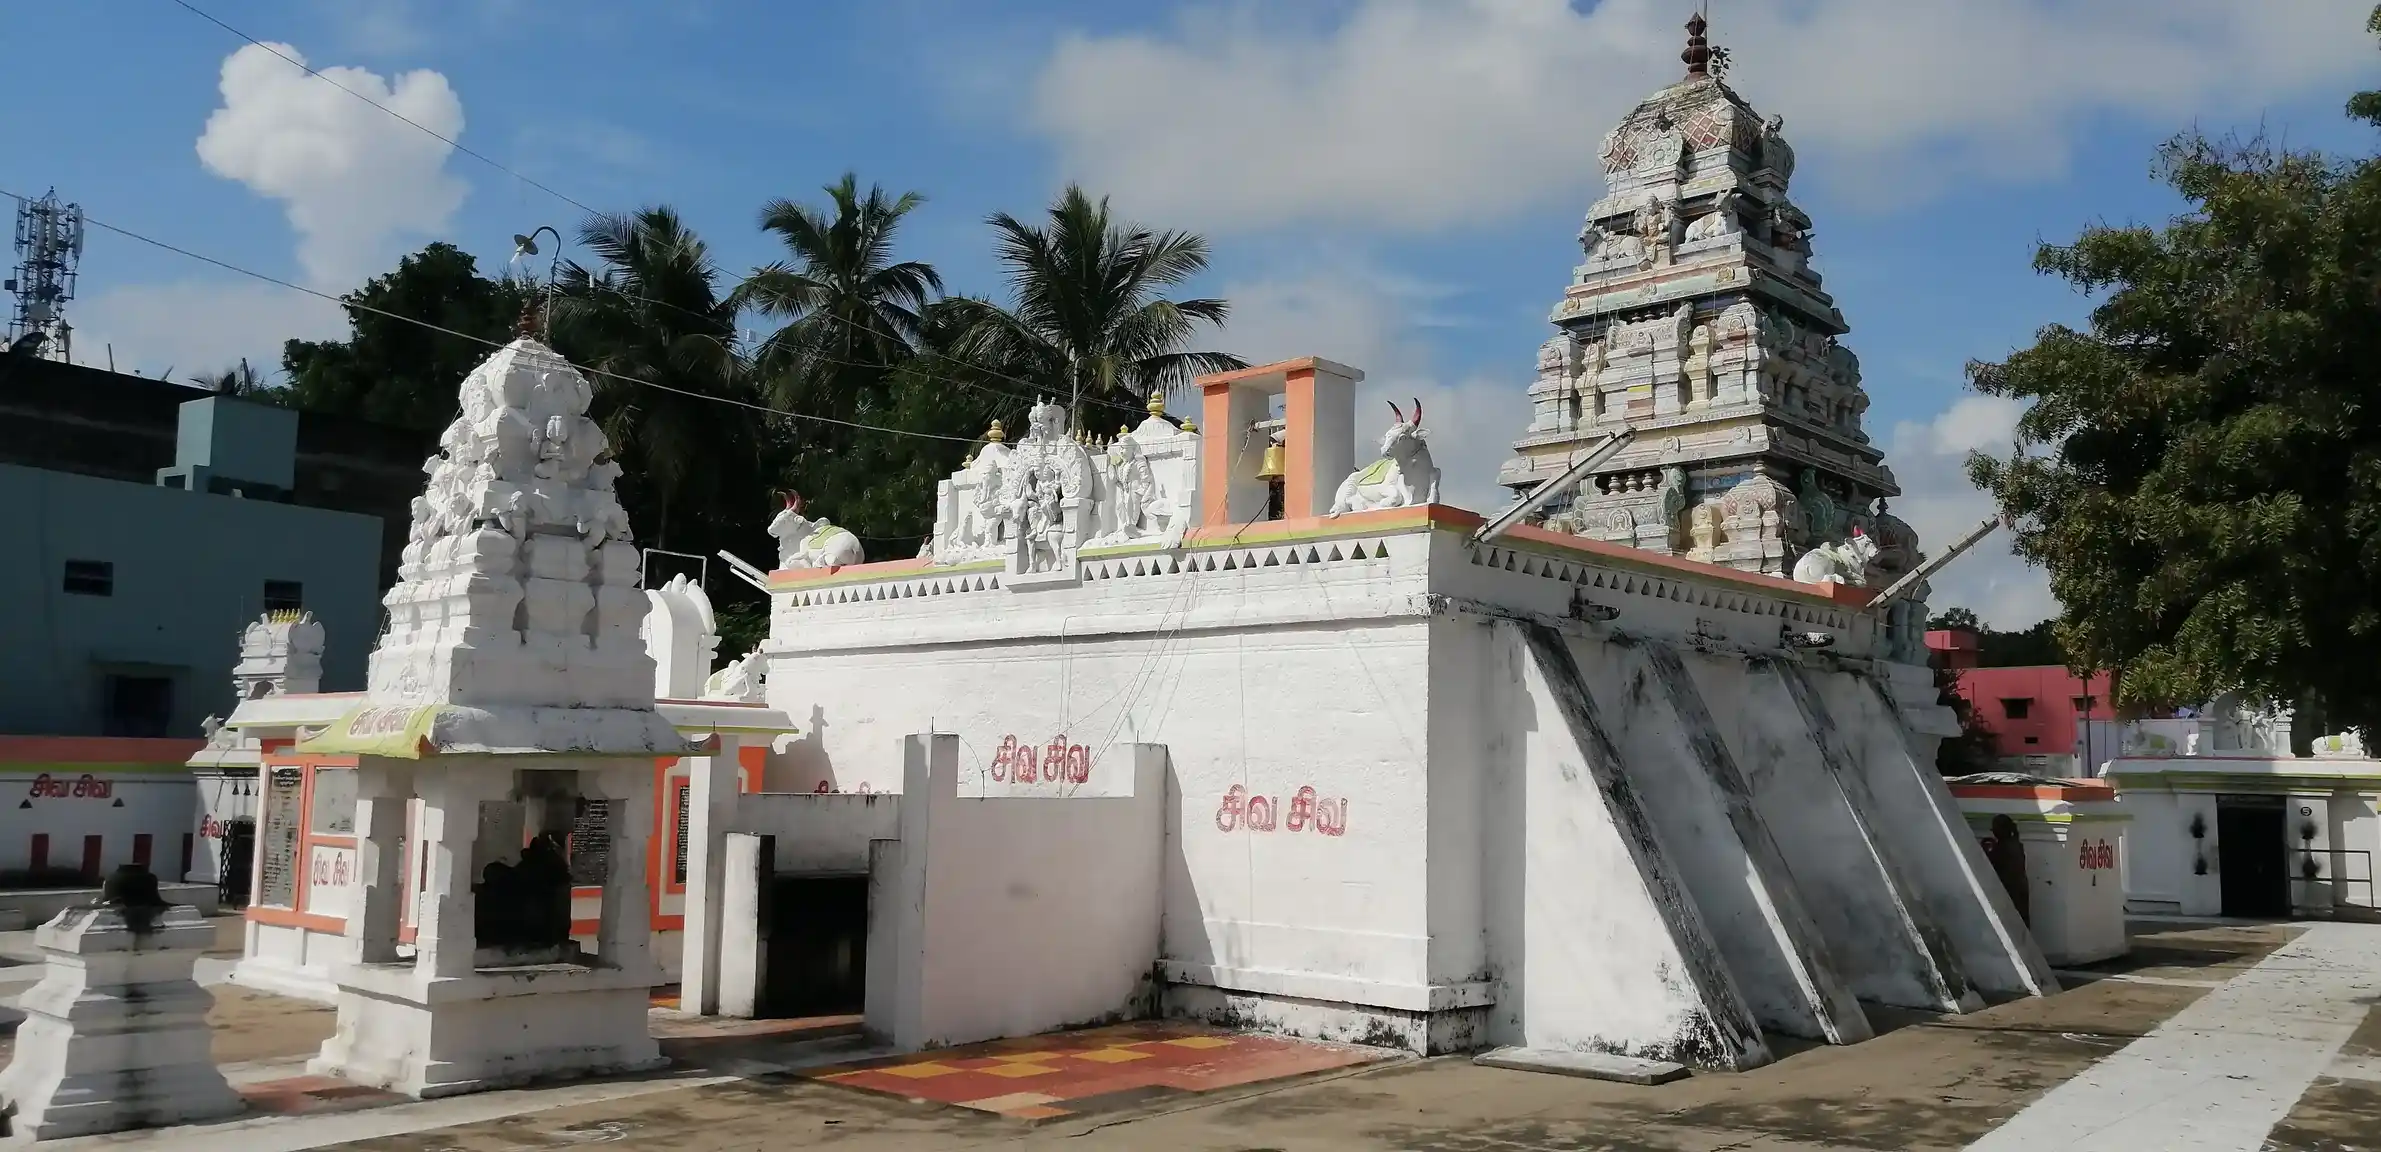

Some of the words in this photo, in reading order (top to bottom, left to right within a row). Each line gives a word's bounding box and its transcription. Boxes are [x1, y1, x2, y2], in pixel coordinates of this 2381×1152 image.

[990, 733, 1037, 784] சிவ
[1043, 733, 1090, 784] சிவ
[30, 773, 70, 798] சிவ
[73, 773, 112, 799] சிவ
[1216, 783, 1278, 833] சிவ
[1285, 785, 1348, 836] சிவ
[2080, 838, 2096, 870] சிவ
[2097, 838, 2113, 870] சிவ
